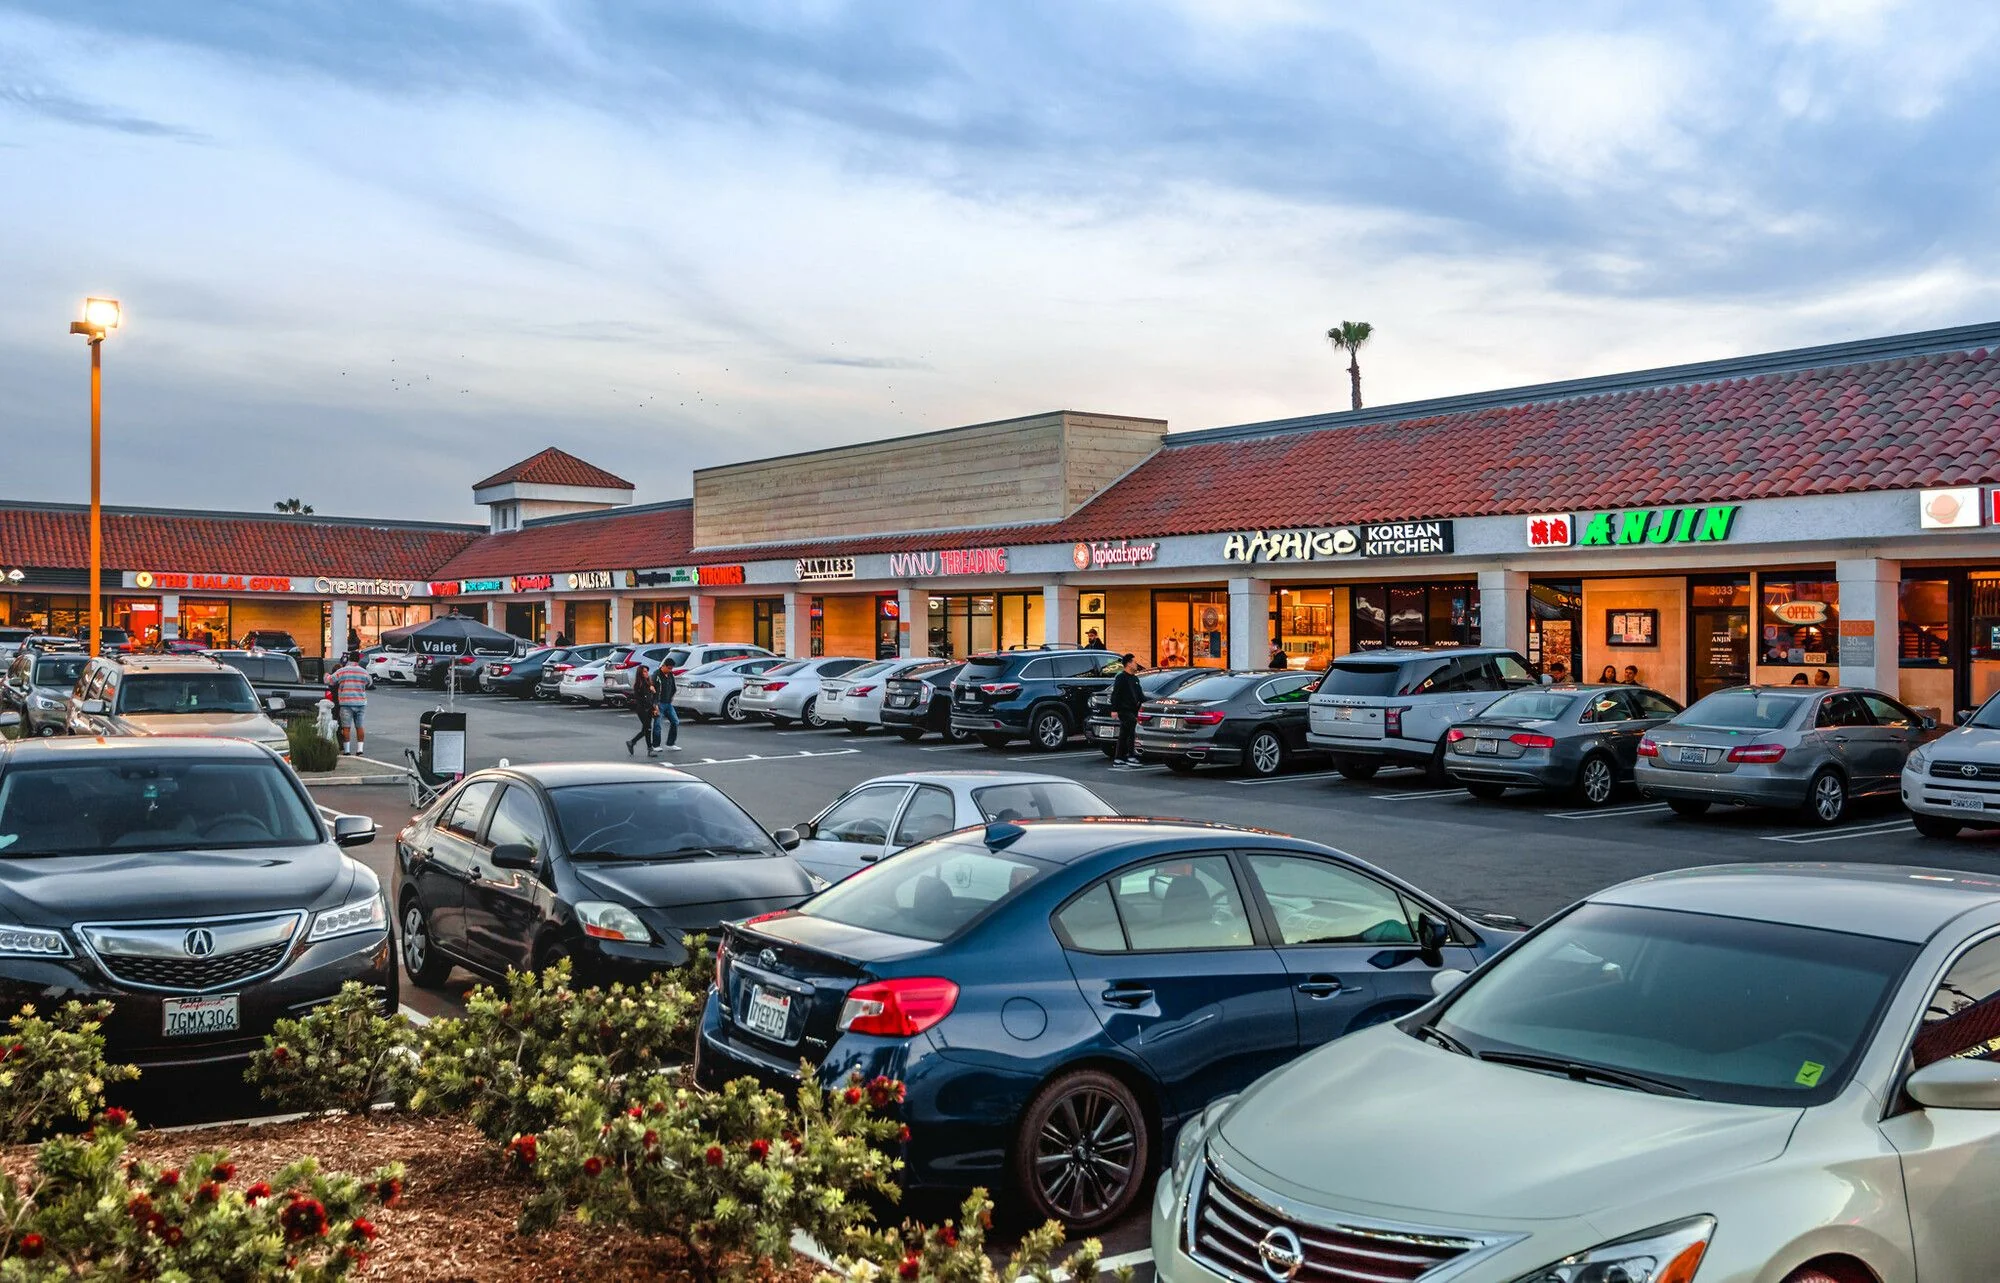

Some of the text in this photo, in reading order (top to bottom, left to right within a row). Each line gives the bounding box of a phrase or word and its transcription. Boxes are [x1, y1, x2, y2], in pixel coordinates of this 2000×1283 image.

[1368, 523, 1440, 540] KOREAN
[1577, 506, 1736, 545] ANJIN
[1224, 529, 1357, 562] HASHIGO
[1366, 538, 1443, 555] KITCHEN
[804, 559, 853, 573] LAWLESS
[940, 548, 1006, 575] THREADING
[153, 573, 189, 588] THE
[192, 575, 246, 590] HALAL
[314, 577, 413, 599] Creamistry
[578, 572, 594, 588] NAILS
[600, 572, 611, 588] SPA
[1709, 586, 1733, 595] 3033
[1787, 606, 1815, 619] OPEN
[422, 641, 458, 653] Valet
[1805, 654, 1825, 662] OPEN
[168, 1008, 234, 1029] 7GMX306
